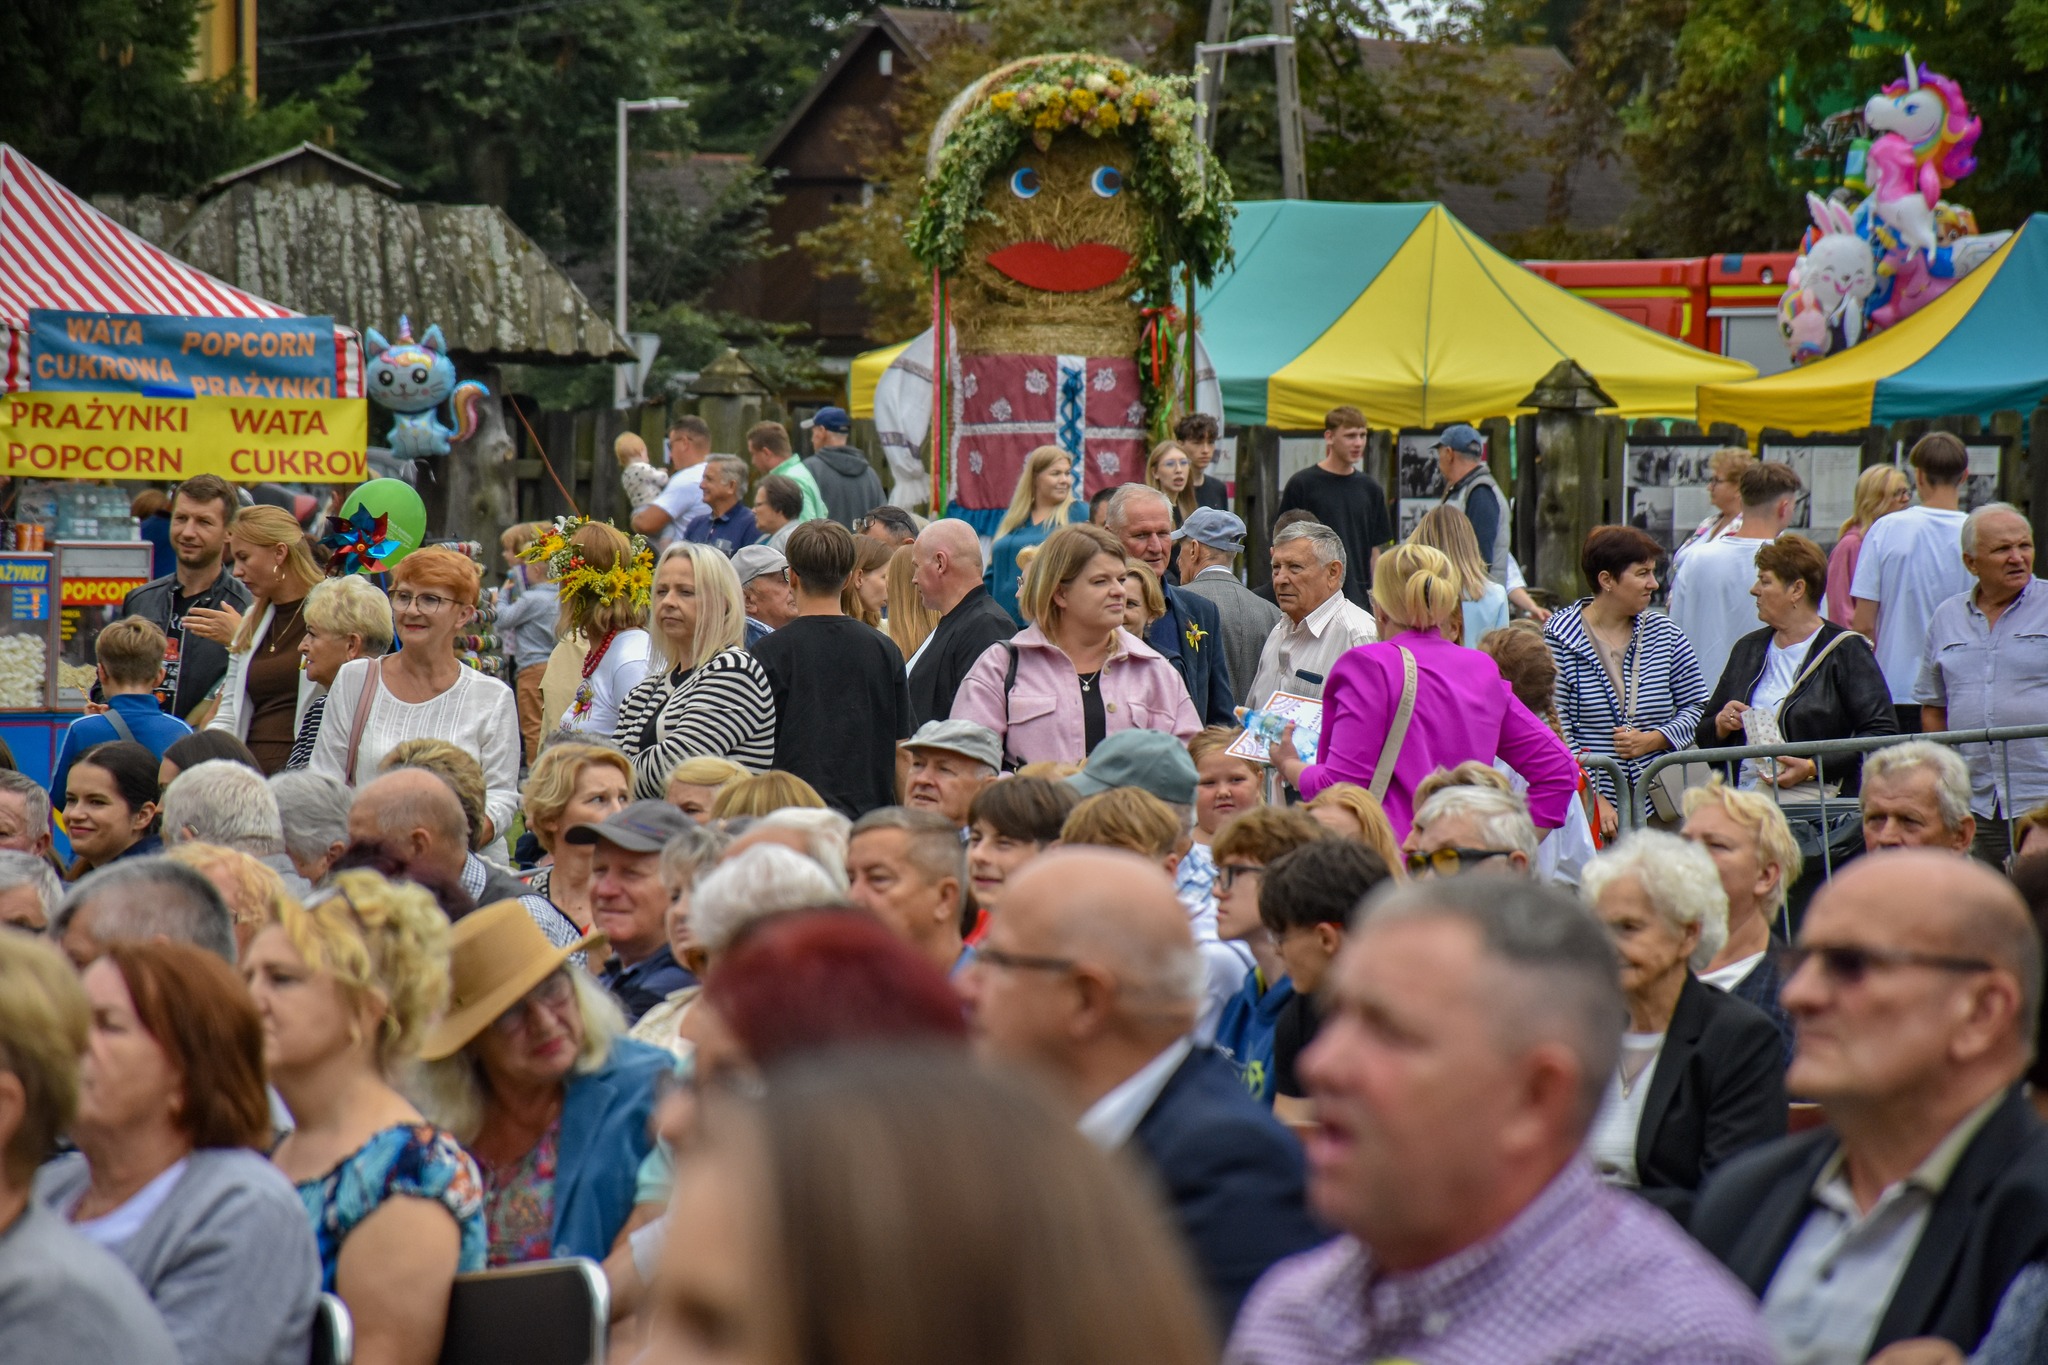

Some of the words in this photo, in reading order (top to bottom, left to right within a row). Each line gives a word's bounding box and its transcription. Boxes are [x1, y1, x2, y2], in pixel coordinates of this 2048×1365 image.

[66, 317, 143, 345] WATA
[181, 331, 316, 357] POPCORN
[36, 353, 179, 382] CUKROWA
[190, 370, 331, 398] PRAŻYNKI
[11, 397, 188, 432] PRAŻYNKI
[230, 407, 329, 435] WATA
[8, 442, 183, 473] POPCORN
